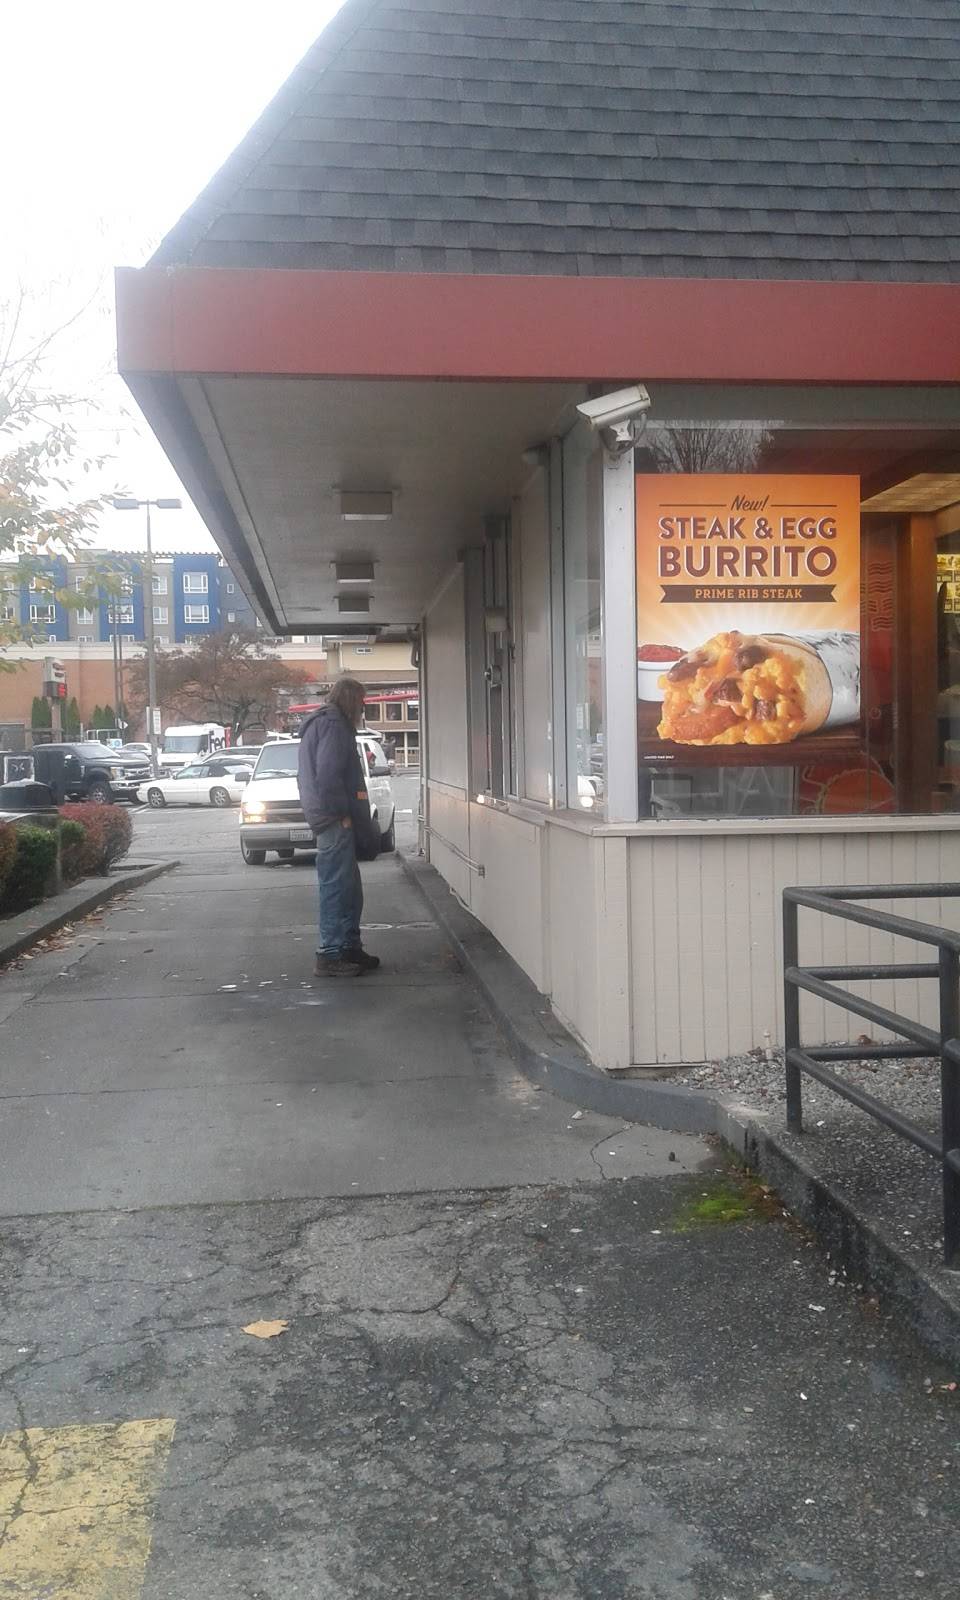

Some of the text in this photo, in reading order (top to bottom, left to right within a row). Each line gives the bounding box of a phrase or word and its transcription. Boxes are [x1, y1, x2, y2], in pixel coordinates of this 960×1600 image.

[731, 495, 769, 511] New!
[658, 516, 837, 540] STEAK & EGG
[658, 545, 837, 578] BURRITO
[695, 588, 803, 599] PRIME RIB STEAK
